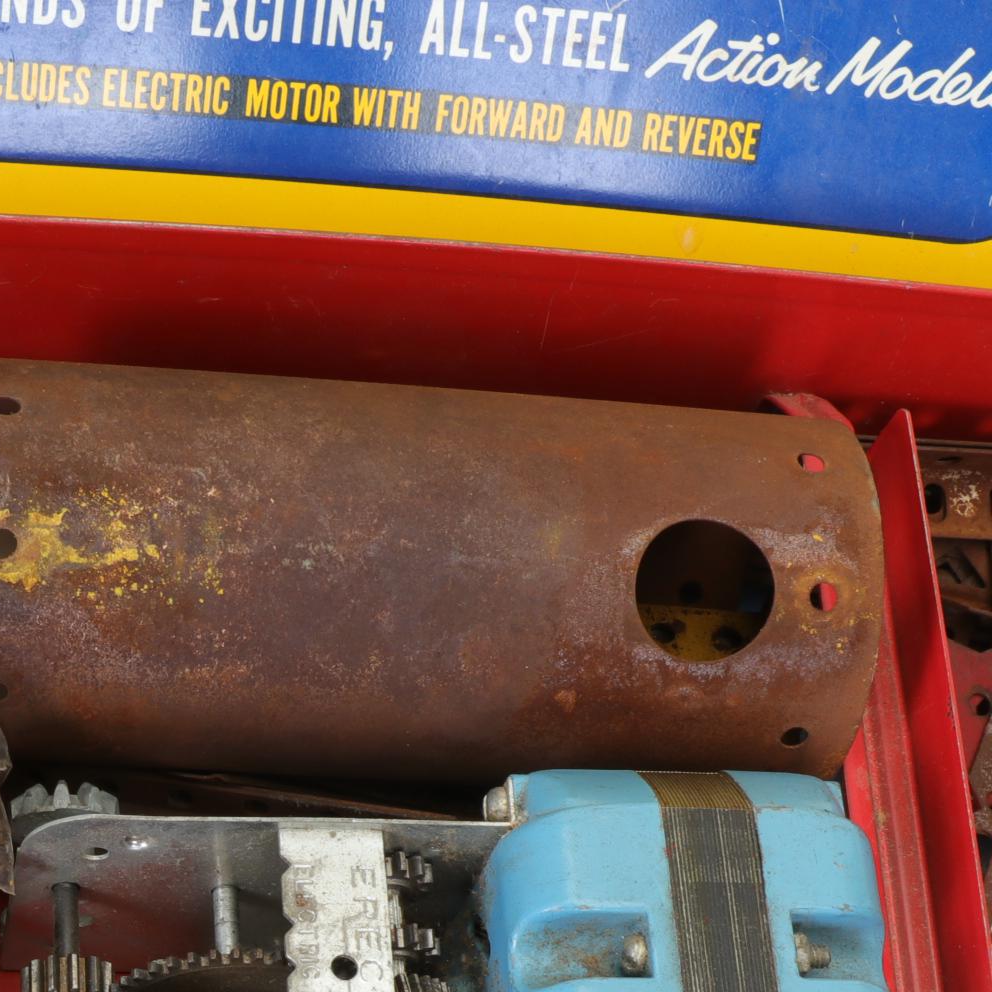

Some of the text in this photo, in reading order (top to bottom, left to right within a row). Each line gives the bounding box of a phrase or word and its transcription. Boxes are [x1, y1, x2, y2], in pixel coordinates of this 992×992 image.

[191, 0, 393, 60] EXCITING,
[419, 0, 630, 72] ALL-STEEL
[644, 18, 823, 92] Action
[102, 68, 230, 115] ELECTRIC
[245, 78, 341, 124] MOTOR
[353, 87, 422, 130] WITH
[435, 94, 566, 142] FORWARD
[574, 107, 633, 148] AND
[642, 112, 761, 161] REVERSE
